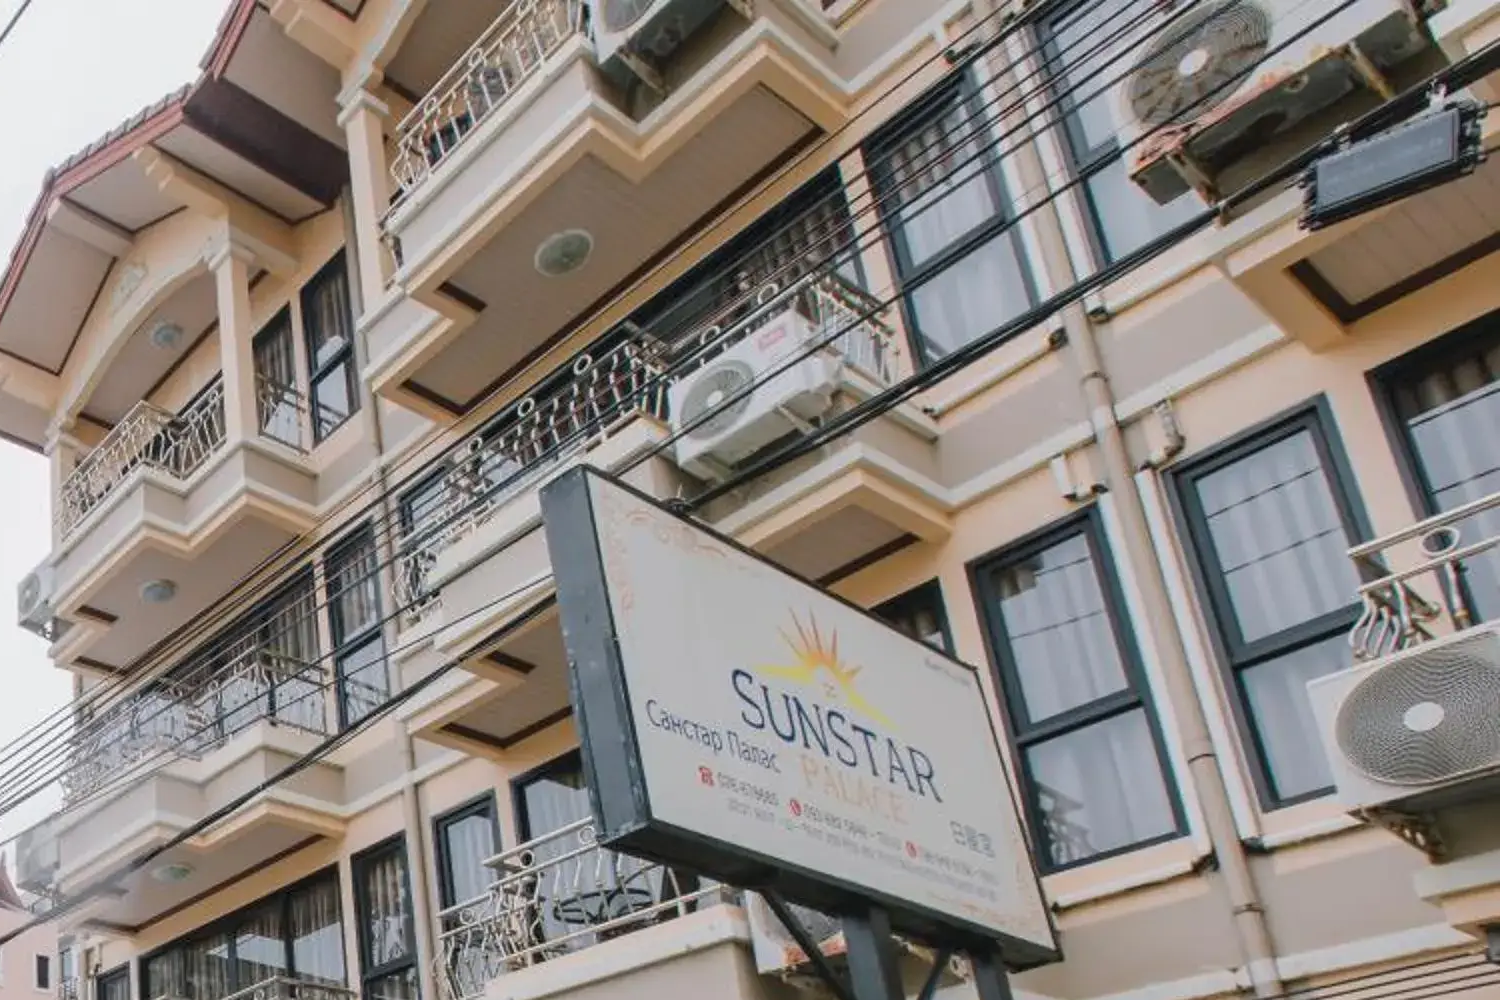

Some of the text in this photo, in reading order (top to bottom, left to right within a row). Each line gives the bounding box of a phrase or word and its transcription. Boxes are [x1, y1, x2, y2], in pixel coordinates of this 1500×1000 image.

[645, 698, 782, 774] Санстар Палас
[731, 668, 943, 804] SUNSTAR
[801, 752, 910, 825] PALACE
